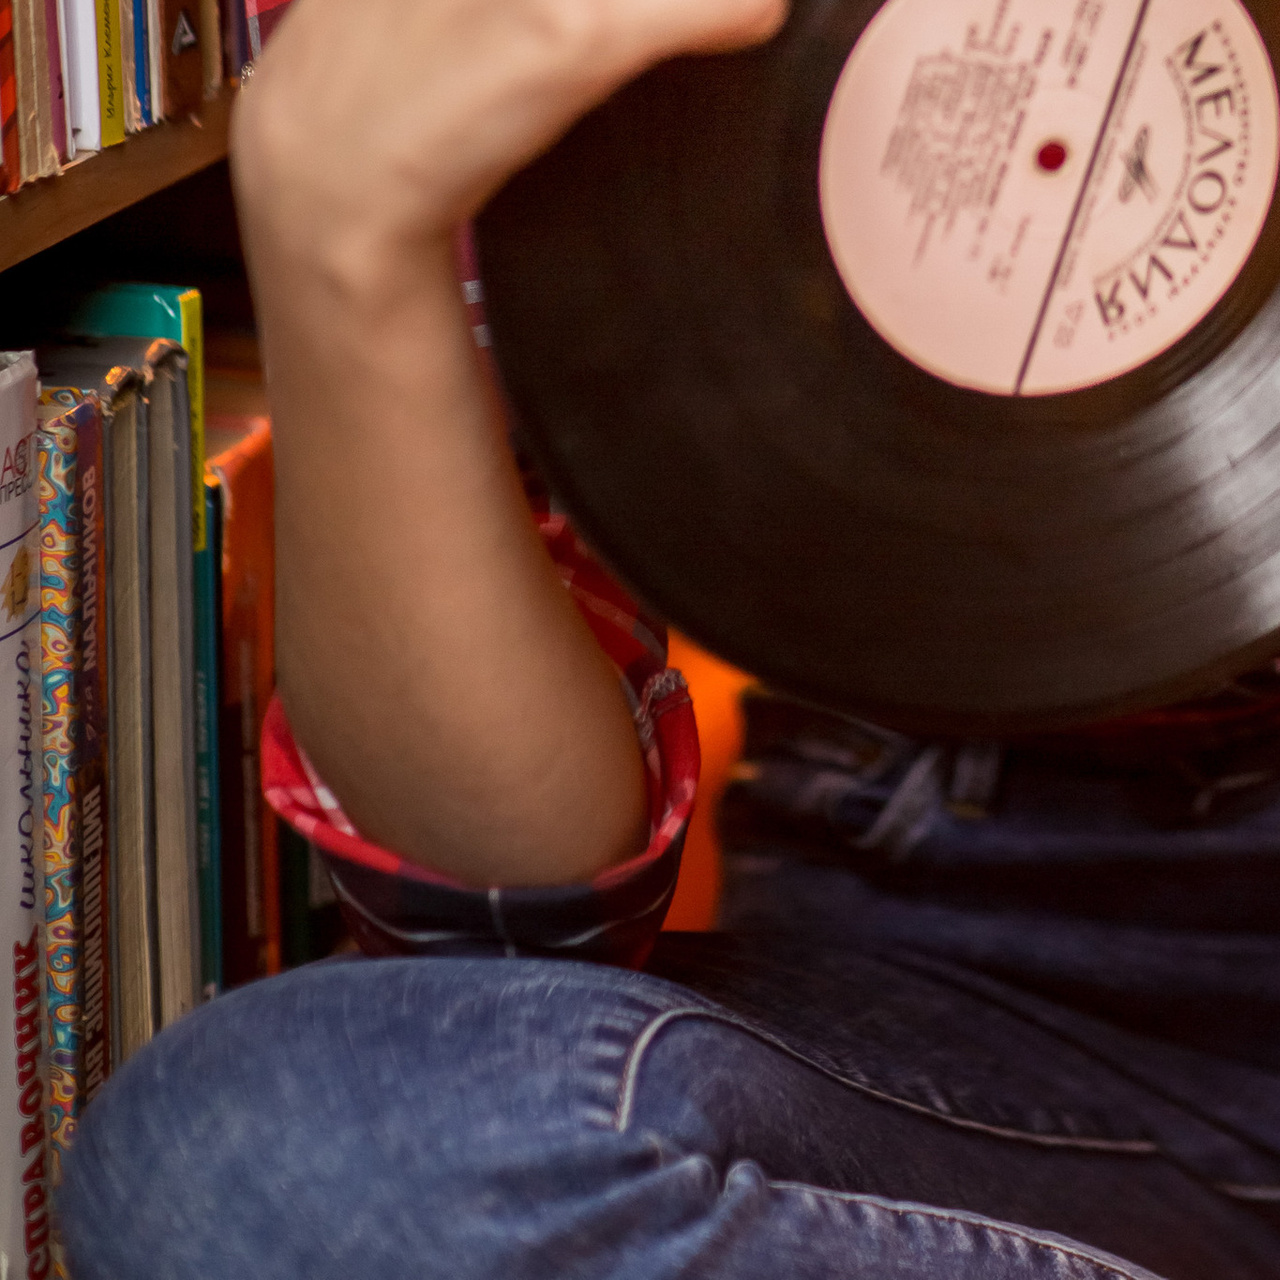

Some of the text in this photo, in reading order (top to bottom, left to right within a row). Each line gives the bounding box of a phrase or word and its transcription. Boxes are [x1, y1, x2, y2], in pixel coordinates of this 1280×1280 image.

[1094, 28, 1236, 328] МЕЛОДИЯ
[82, 465, 97, 672] МАЛЬЧИКОВ
[14, 640, 49, 1280] СПРАВОЧНИК школьника
[81, 784, 105, 1039] ЭНЦИКЛОПЕДИЯ
